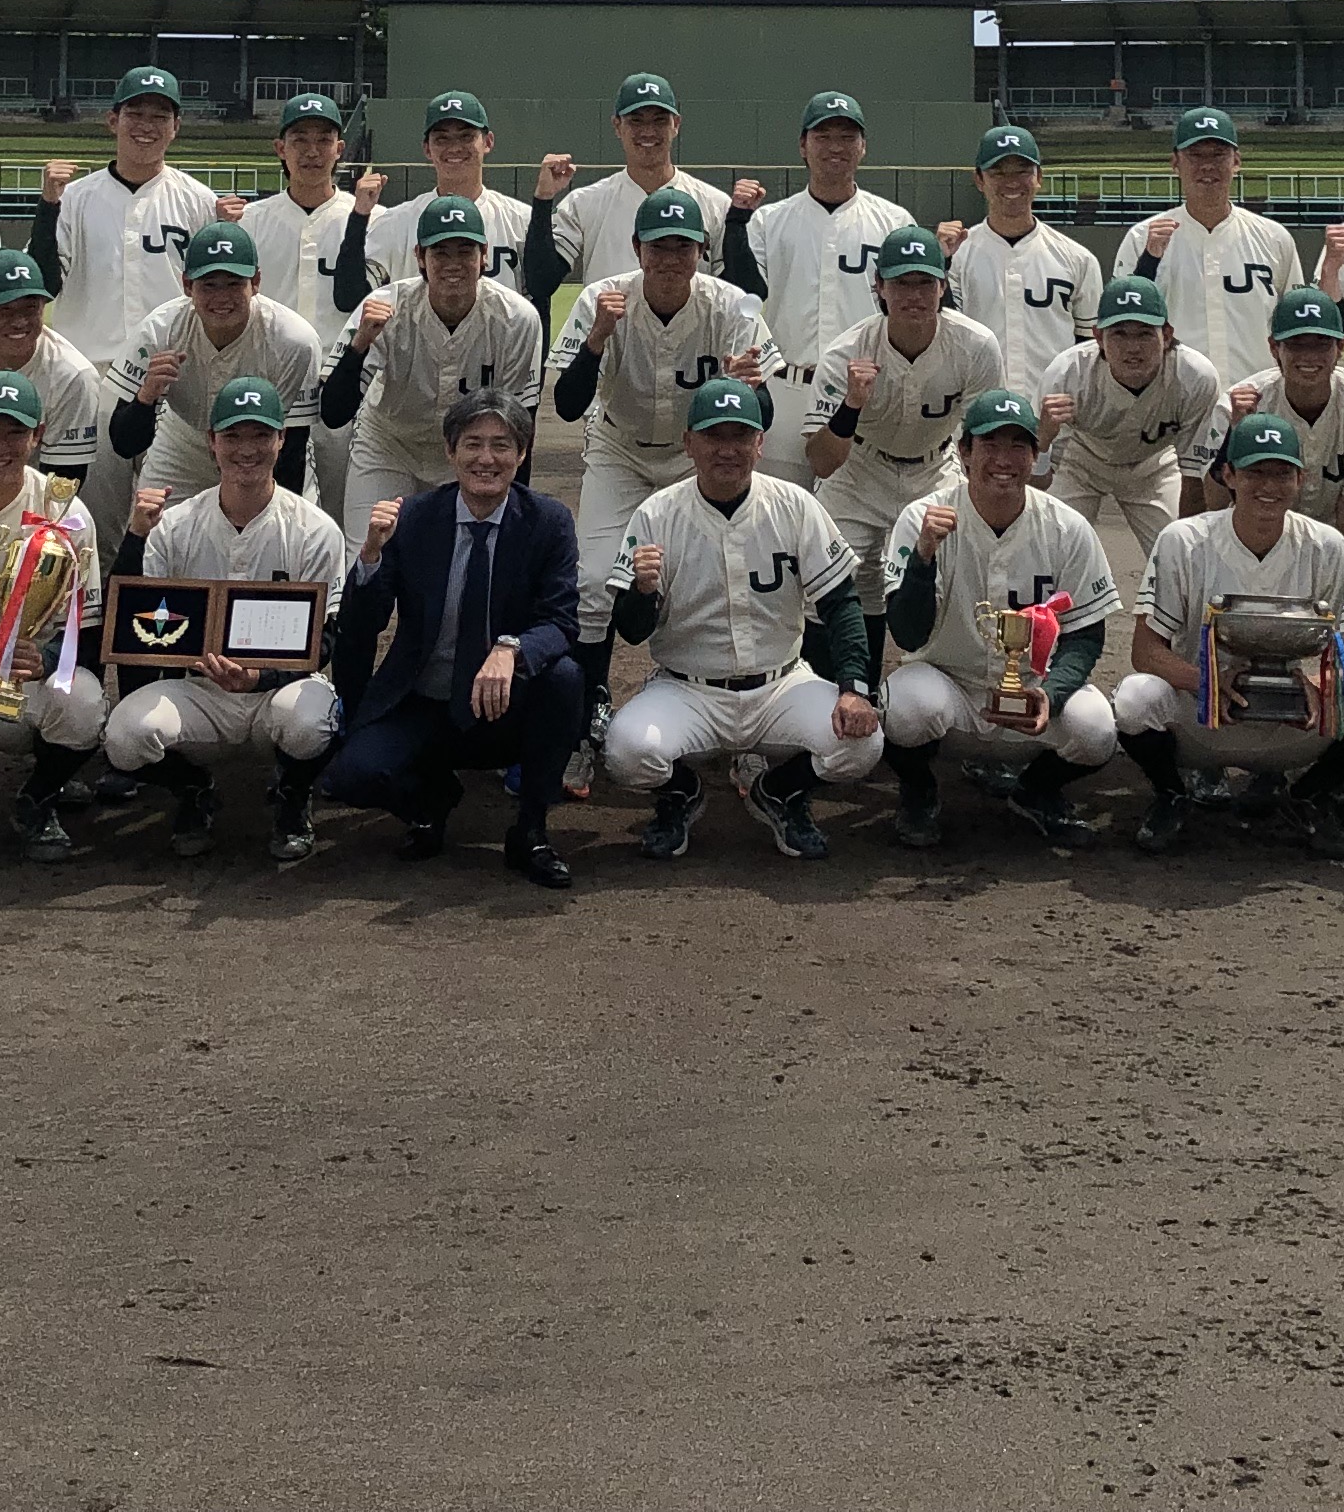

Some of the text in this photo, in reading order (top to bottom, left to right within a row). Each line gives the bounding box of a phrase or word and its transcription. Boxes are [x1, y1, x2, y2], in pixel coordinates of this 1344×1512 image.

[140, 74, 165, 88] JR
[637, 82, 661, 96] JR
[299, 99, 323, 112] JR
[439, 99, 463, 111] JR
[826, 98, 849, 111] JR
[1194, 117, 1219, 130] JR
[996, 134, 1021, 147] JR
[440, 209, 466, 223] JR
[660, 204, 685, 220] JR
[142, 224, 191, 262] JR
[207, 240, 234, 255] JR
[901, 241, 926, 257] JR
[5, 266, 32, 280] JR
[1223, 262, 1274, 297] JR
[1024, 277, 1075, 313] JR
[1116, 291, 1142, 306] JR
[1295, 304, 1322, 318] JR
[124, 359, 147, 381] TOKY
[234, 391, 262, 407] JR
[714, 393, 742, 409] JR
[995, 399, 1021, 416] JR
[1255, 429, 1282, 444] JR
[1092, 576, 1113, 595] EAST
